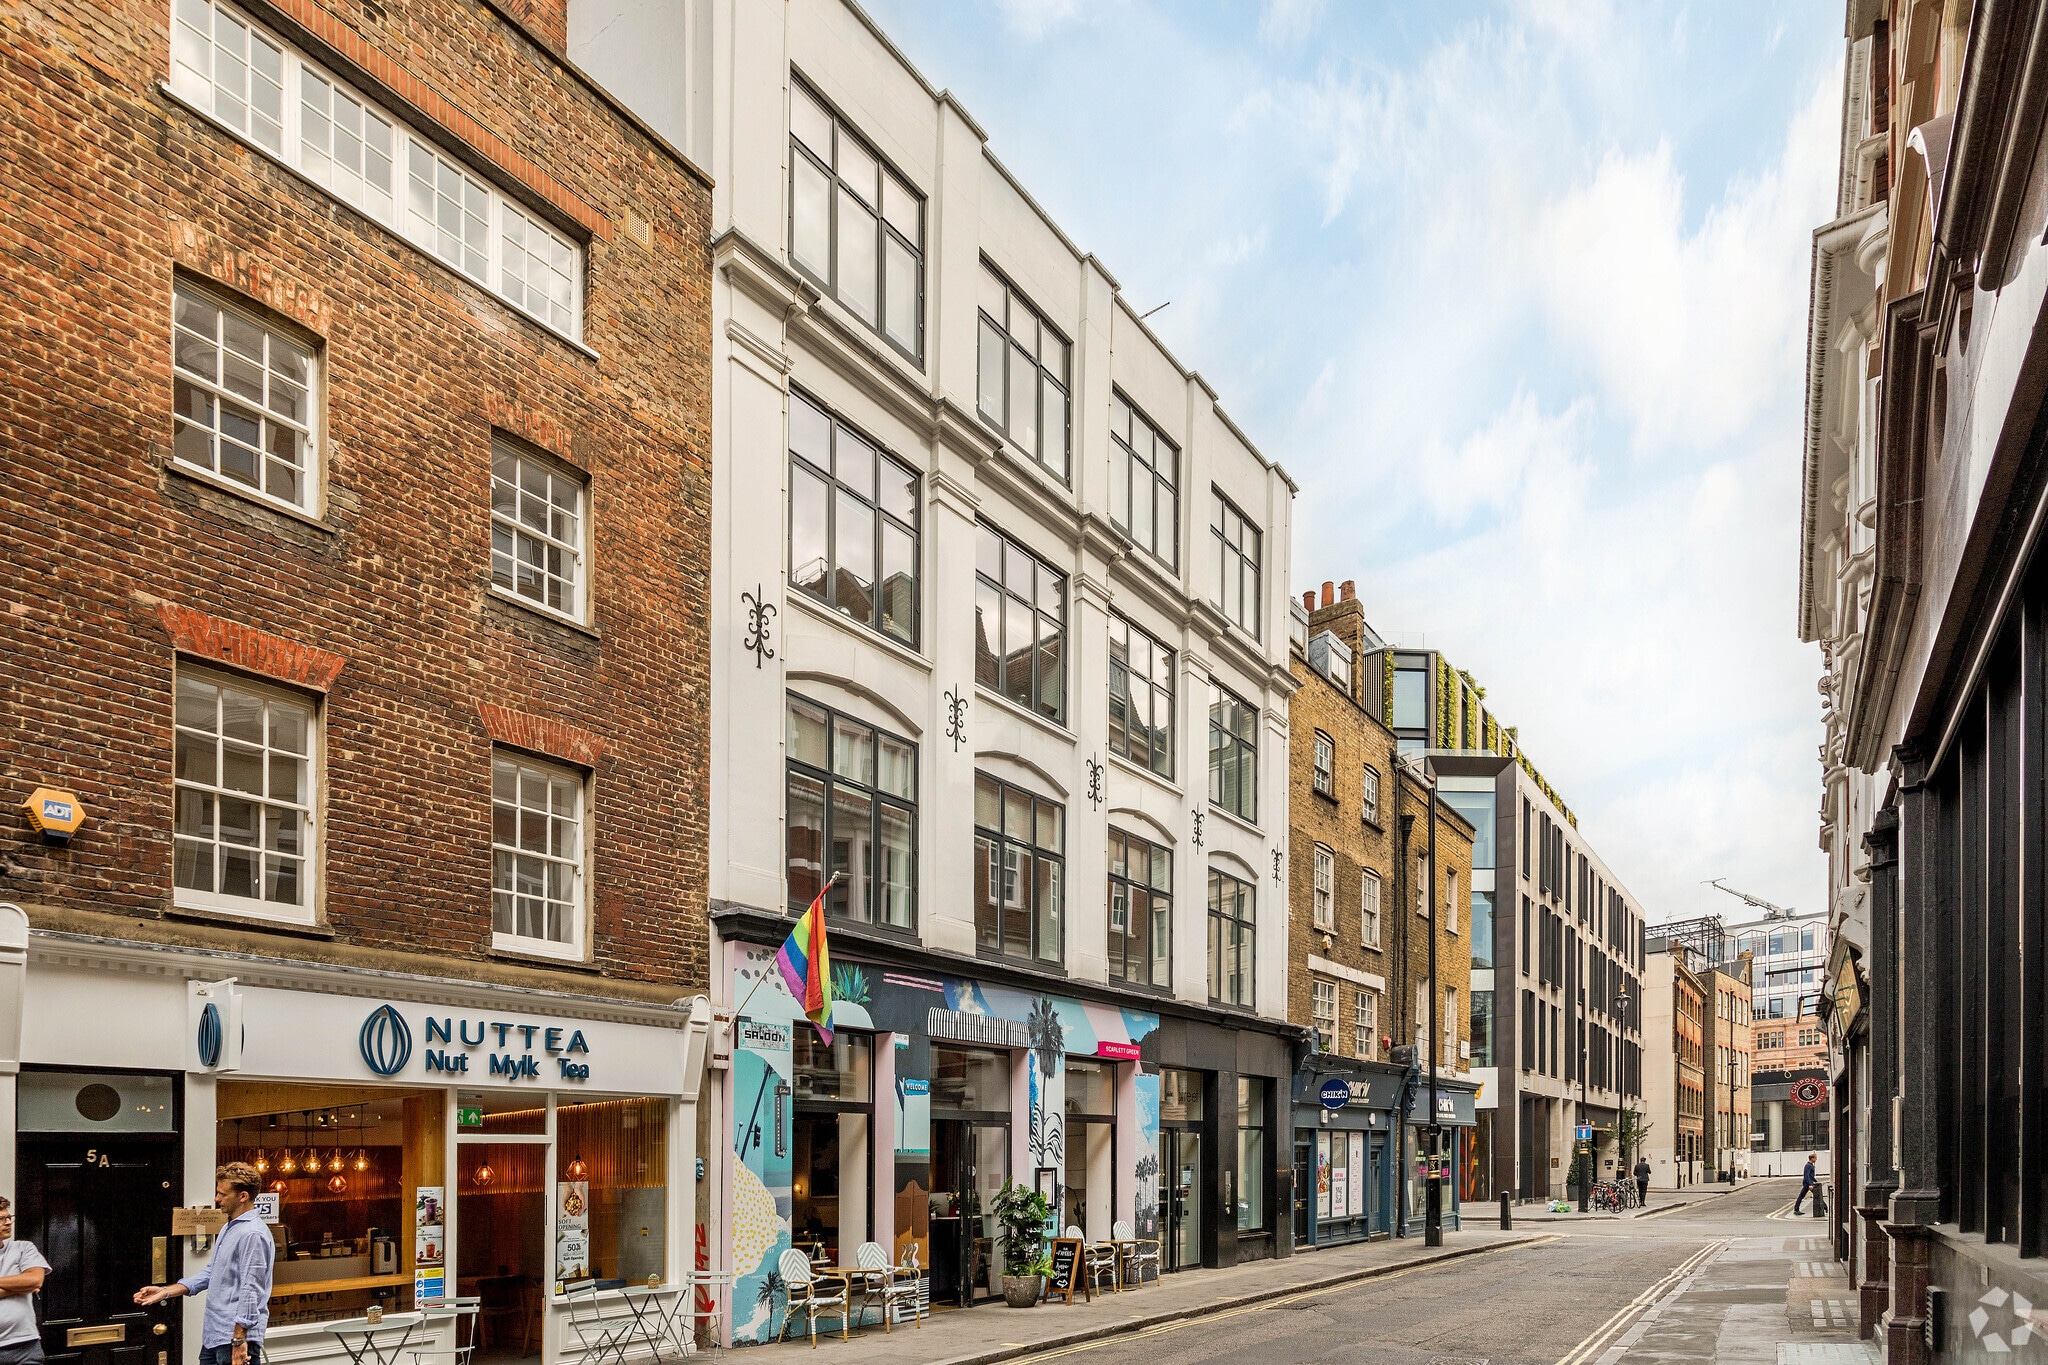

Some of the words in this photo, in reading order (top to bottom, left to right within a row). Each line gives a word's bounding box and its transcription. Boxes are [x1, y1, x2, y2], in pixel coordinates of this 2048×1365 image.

[44, 804, 72, 818] ADT
[425, 1016, 590, 1053] NUTTEA
[1105, 1045, 1126, 1054] SCARLETT
[1126, 1047, 1139, 1055] GREEN
[425, 1049, 469, 1072] Nut
[489, 1053, 540, 1081] Mylk
[556, 1057, 590, 1079] Tea
[905, 1083, 928, 1091] WELCOME
[1790, 1077, 1824, 1094] CHIPOTLE
